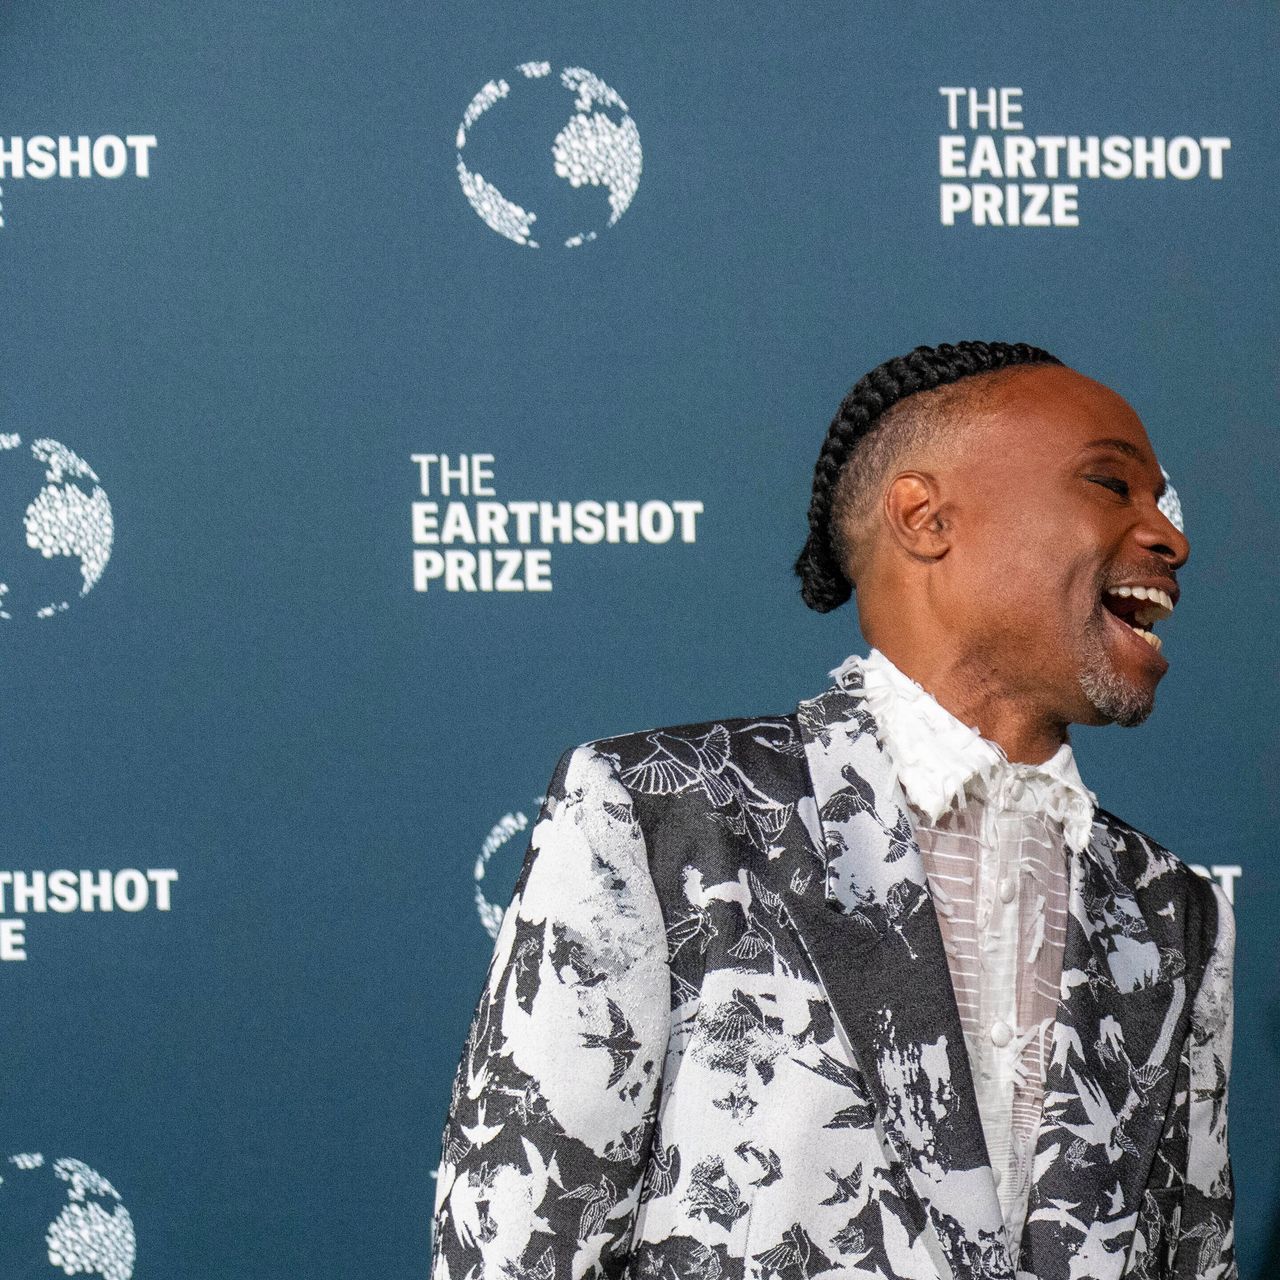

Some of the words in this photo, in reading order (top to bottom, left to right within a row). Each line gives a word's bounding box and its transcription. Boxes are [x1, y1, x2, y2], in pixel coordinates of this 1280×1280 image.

[938, 86, 1024, 130] THE
[939, 135, 1232, 180] EARTHSHOT
[940, 183, 1080, 227] PRIZE
[410, 453, 496, 497] THE
[411, 500, 704, 544] EARTHSHOT
[413, 549, 553, 592] PRIZE
